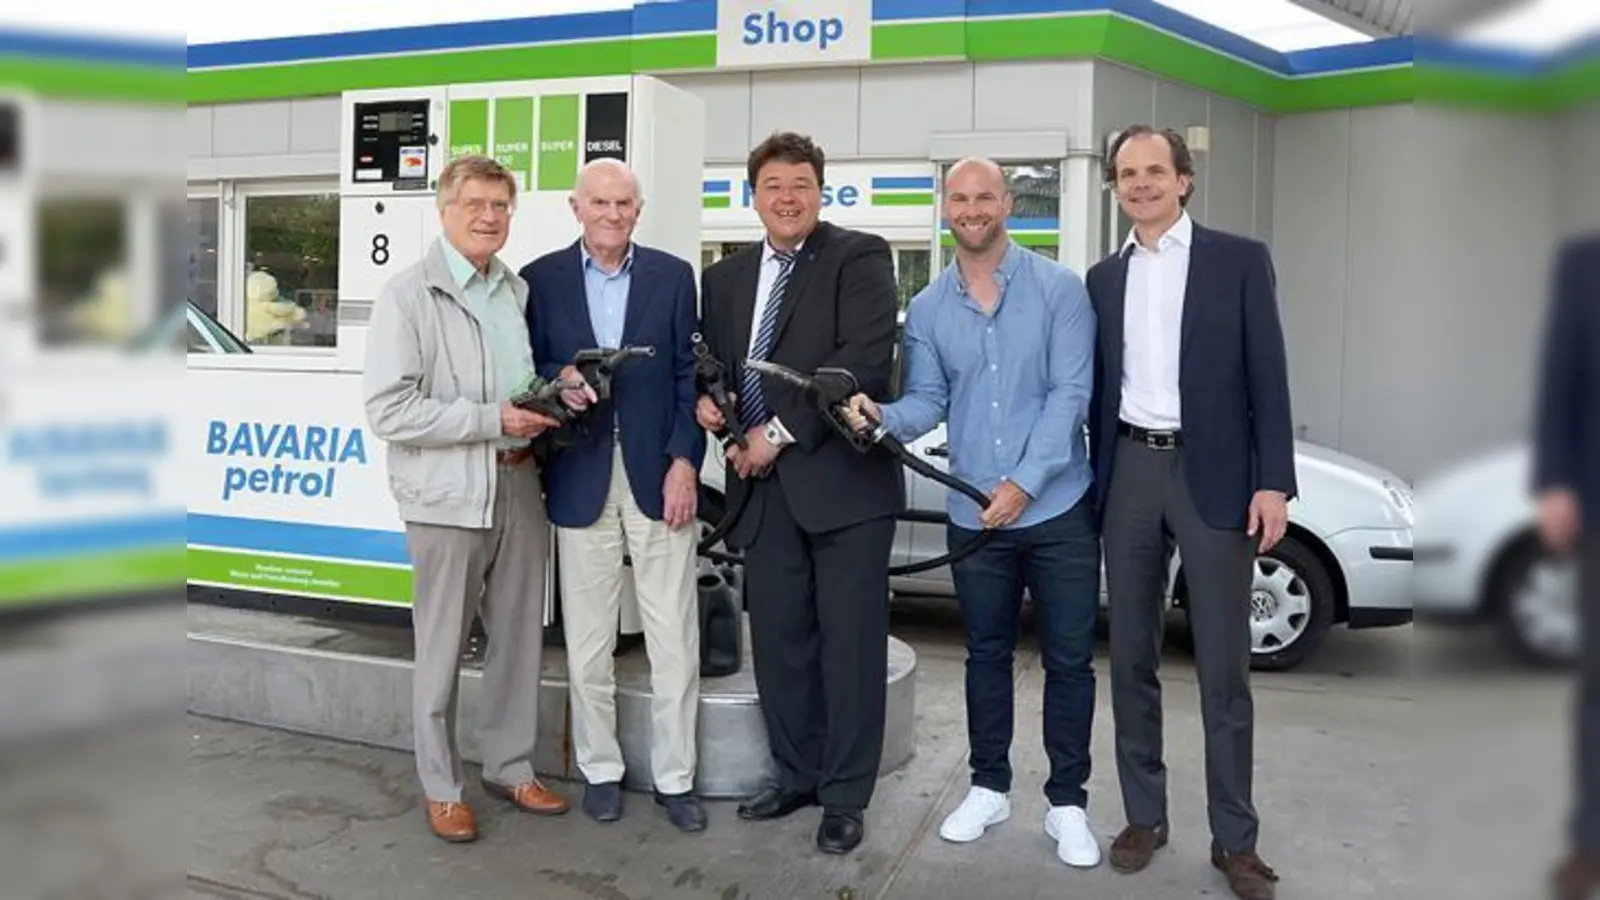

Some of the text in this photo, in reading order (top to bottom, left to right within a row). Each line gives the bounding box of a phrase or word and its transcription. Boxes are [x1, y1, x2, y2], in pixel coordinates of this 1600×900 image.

[743, 11, 844, 50] Shop
[541, 140, 575, 152] SUPER
[586, 140, 623, 153] DIESEL
[370, 233, 390, 266] 8
[206, 419, 367, 465] BAVARIA
[222, 463, 336, 501] petrol
